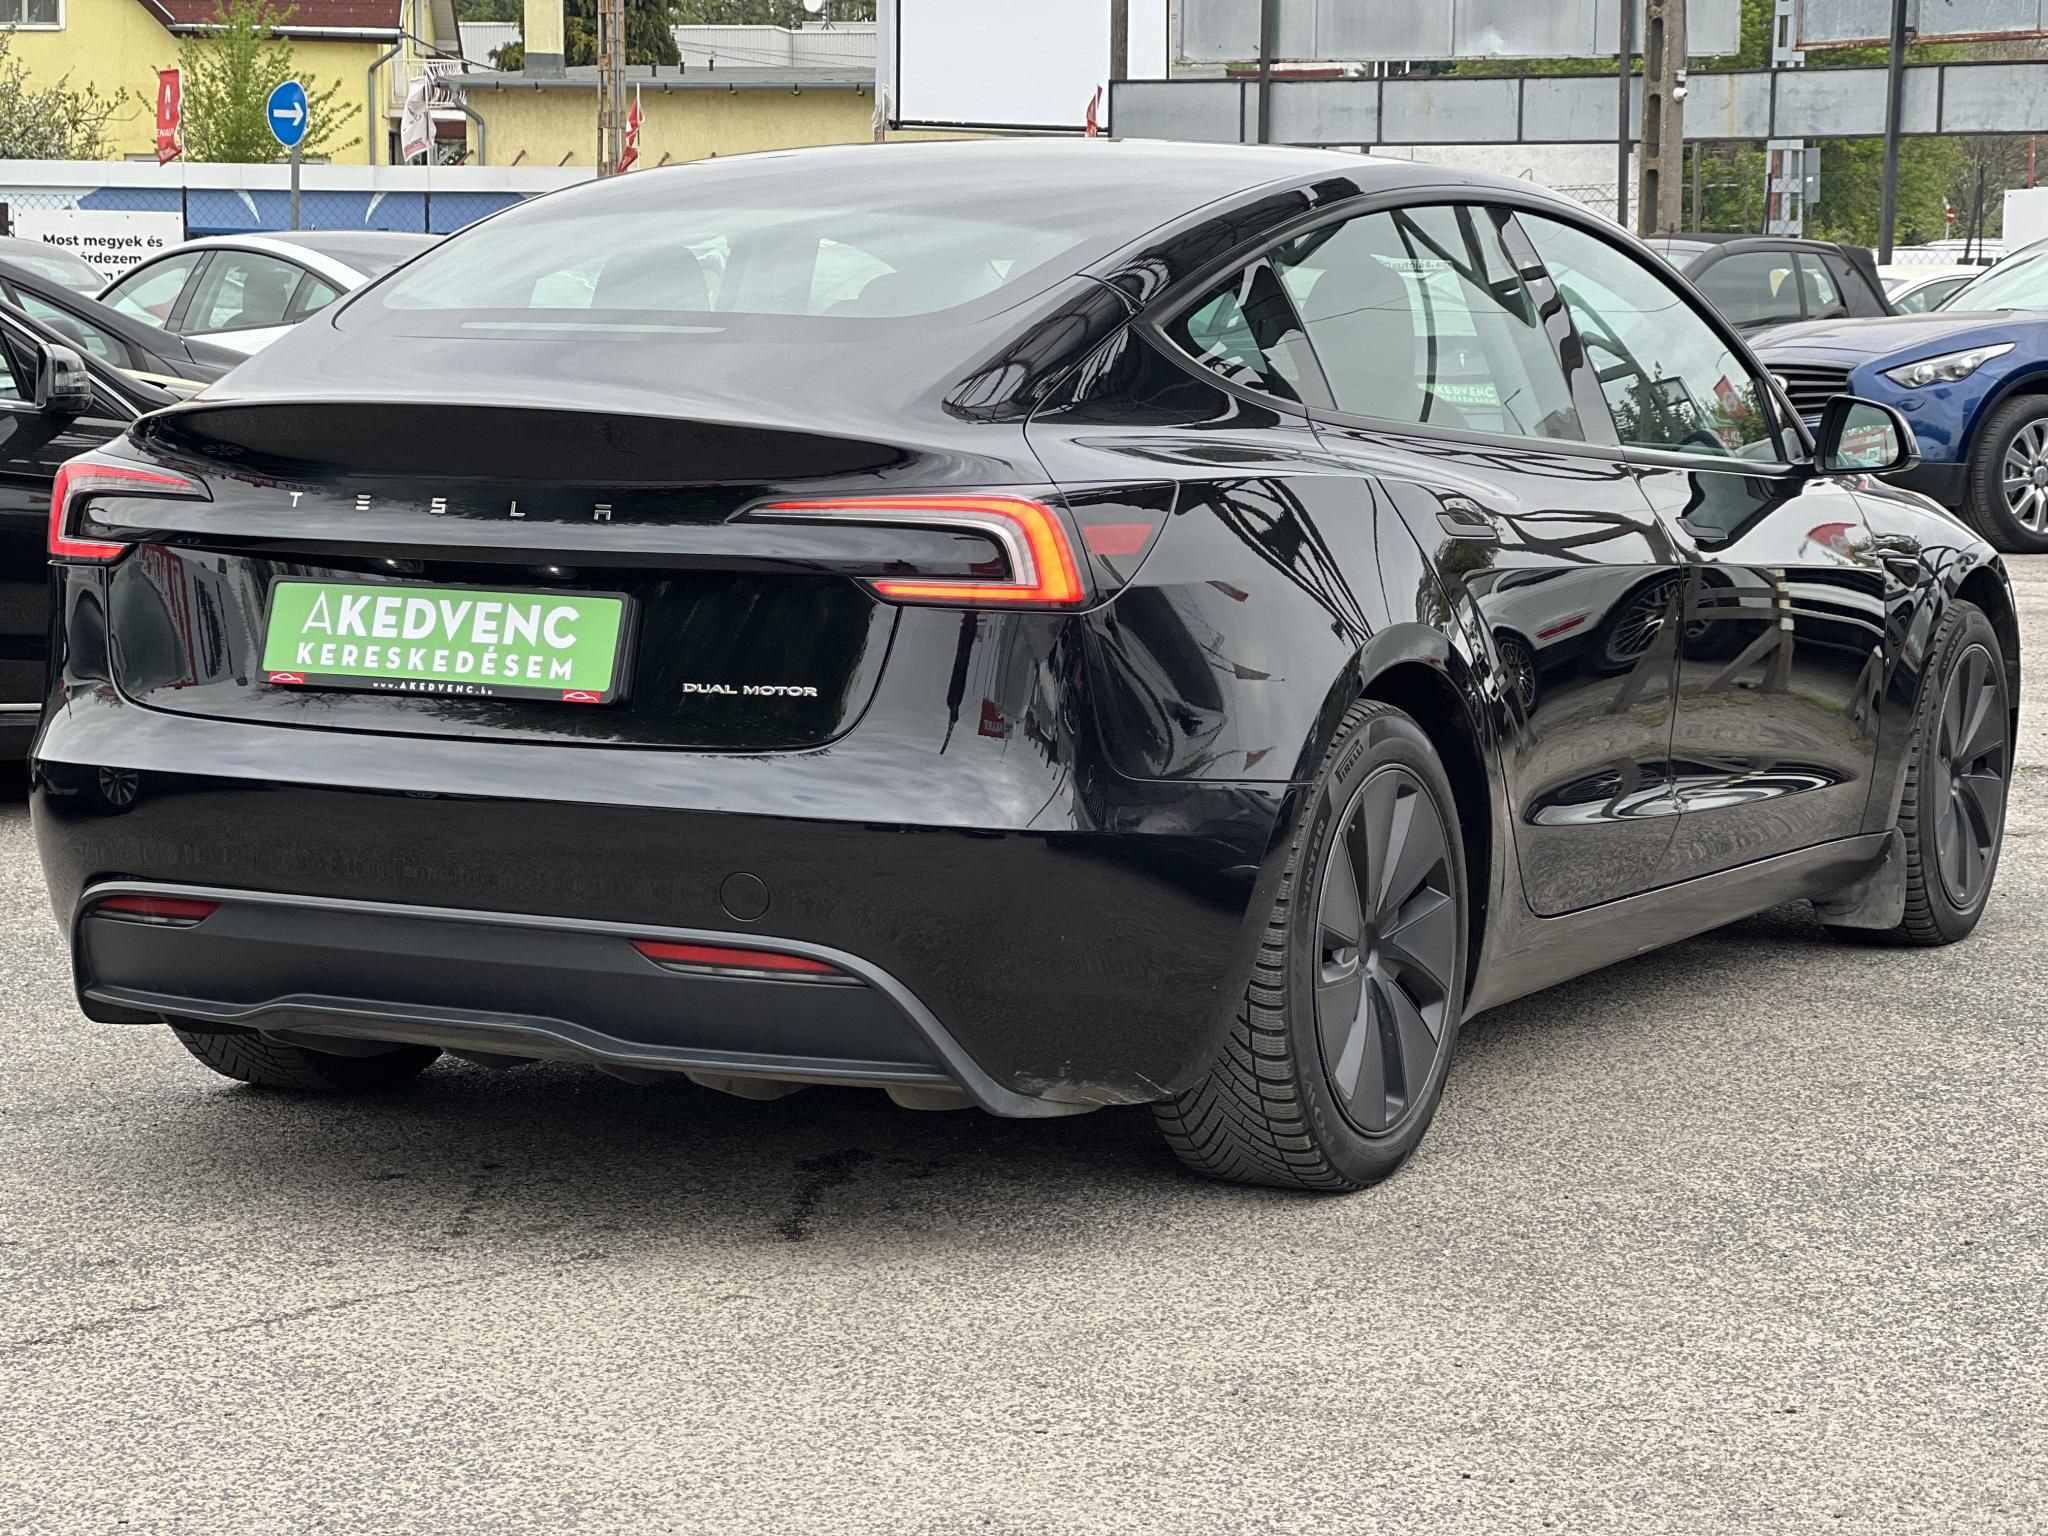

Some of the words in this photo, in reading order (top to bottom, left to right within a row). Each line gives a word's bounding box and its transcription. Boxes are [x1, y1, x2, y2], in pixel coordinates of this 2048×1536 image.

[43, 234, 79, 246] Most
[84, 235, 143, 249] megyek
[147, 235, 163, 247] és
[289, 491, 612, 521] TESLA
[301, 590, 580, 649] AKEDVENC
[296, 642, 573, 680] KERESKEDÉSEM
[373, 681, 492, 695] www.AKEDVENC.hu
[682, 683, 738, 694] DUAL
[743, 685, 817, 697] MOTOR
[1335, 739, 1364, 784] PIRELLI
